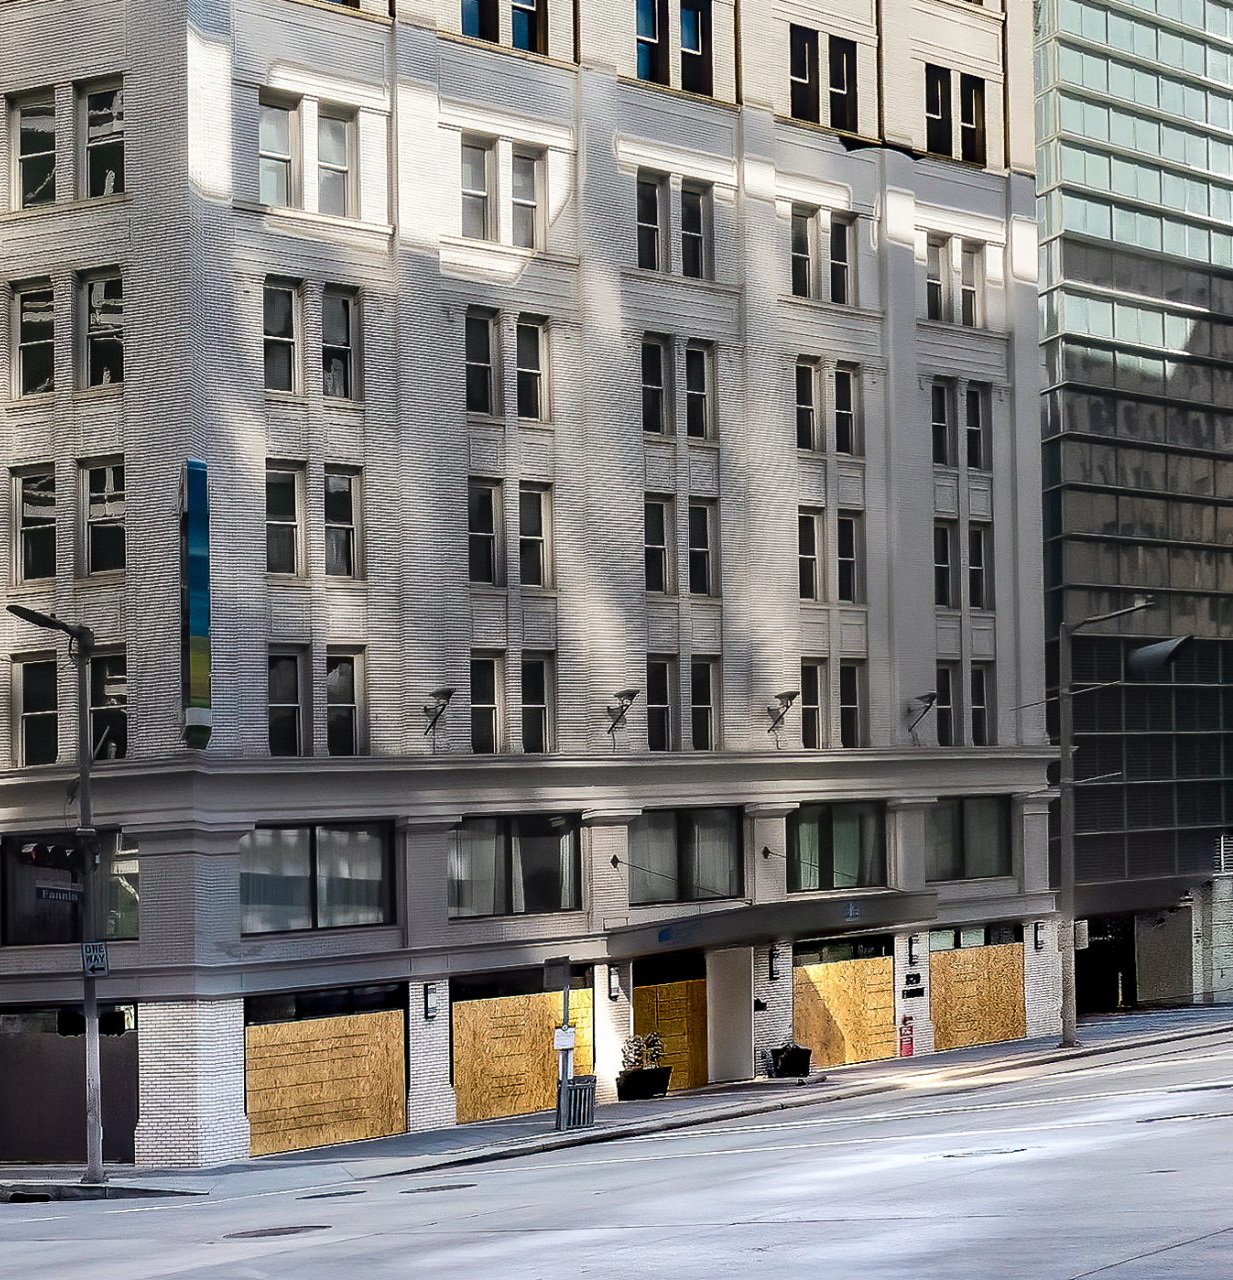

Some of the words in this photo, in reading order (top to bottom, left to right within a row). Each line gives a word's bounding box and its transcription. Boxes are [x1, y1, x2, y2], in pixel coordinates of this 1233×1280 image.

[42, 889, 78, 901] Fannin
[85, 945, 105, 954] ONE
[86, 954, 105, 964] WAY
